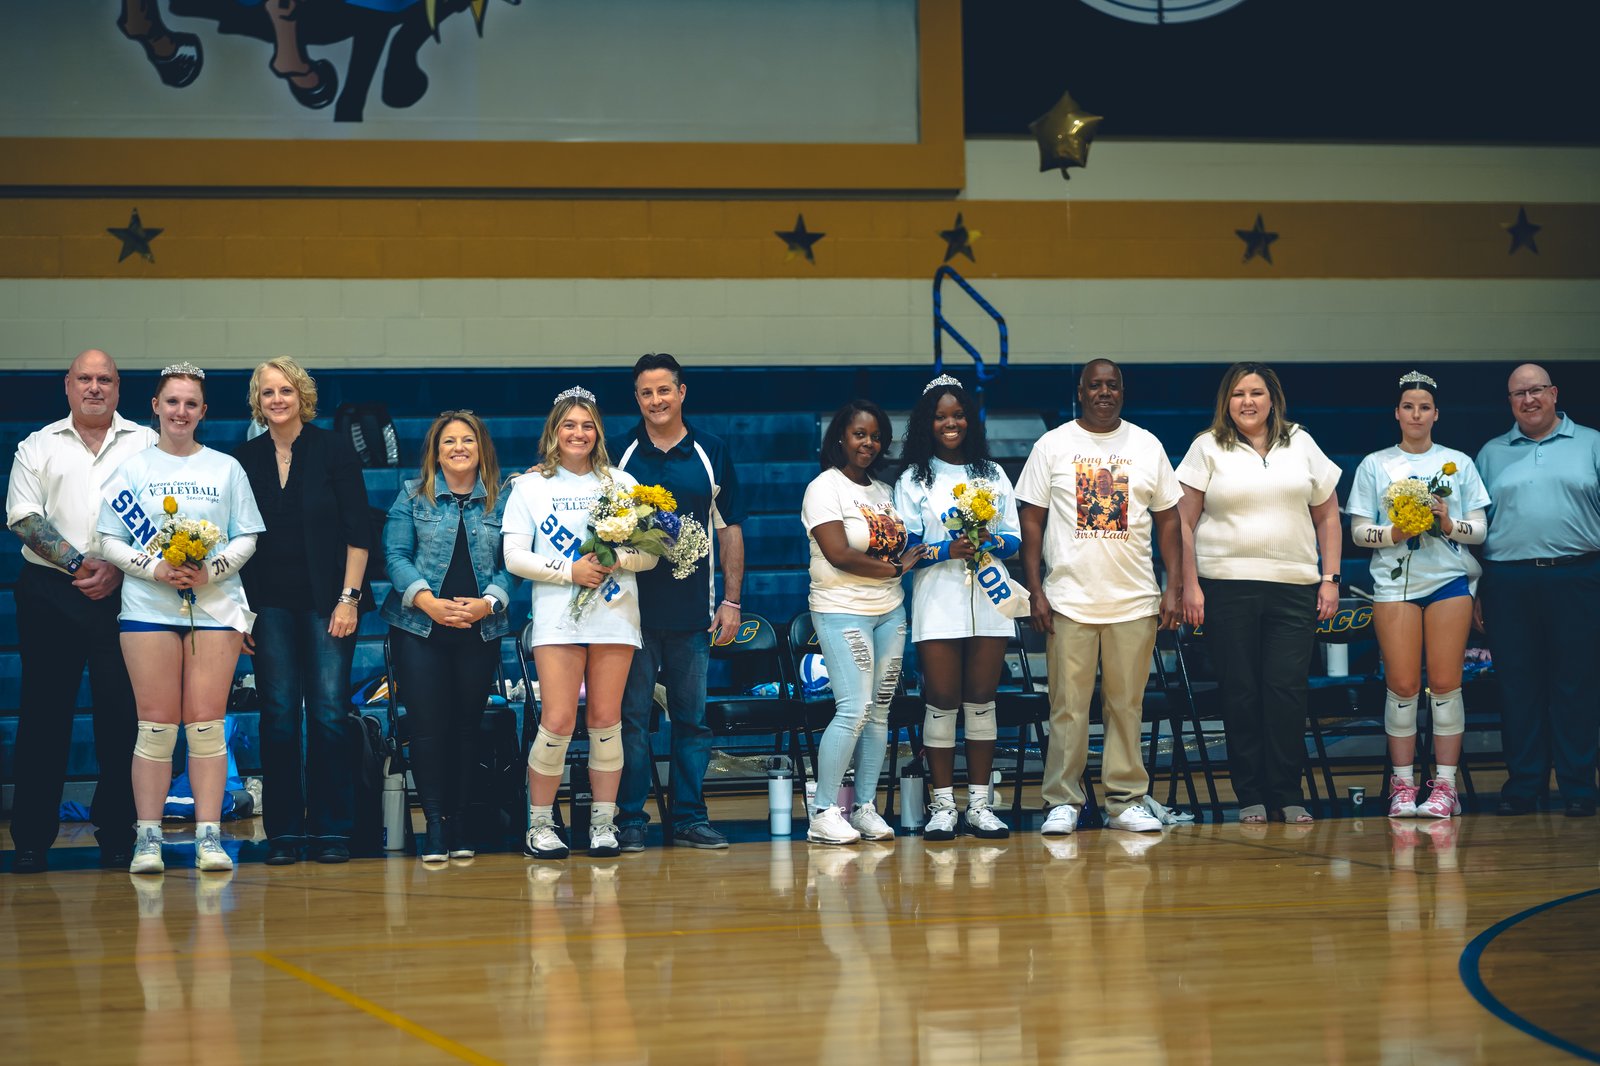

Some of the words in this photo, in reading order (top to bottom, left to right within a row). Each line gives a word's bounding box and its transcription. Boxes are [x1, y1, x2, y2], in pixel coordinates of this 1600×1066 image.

[1071, 453, 1102, 466] Long
[1106, 453, 1133, 465] Live
[149, 486, 220, 497] VOLLEYBALL
[205, 496, 219, 504] Night
[111, 489, 158, 547] SEN
[1074, 528, 1099, 540] First
[1101, 528, 1130, 543] Lady
[1316, 606, 1374, 633] ACC
[1352, 792, 1364, 805] G
